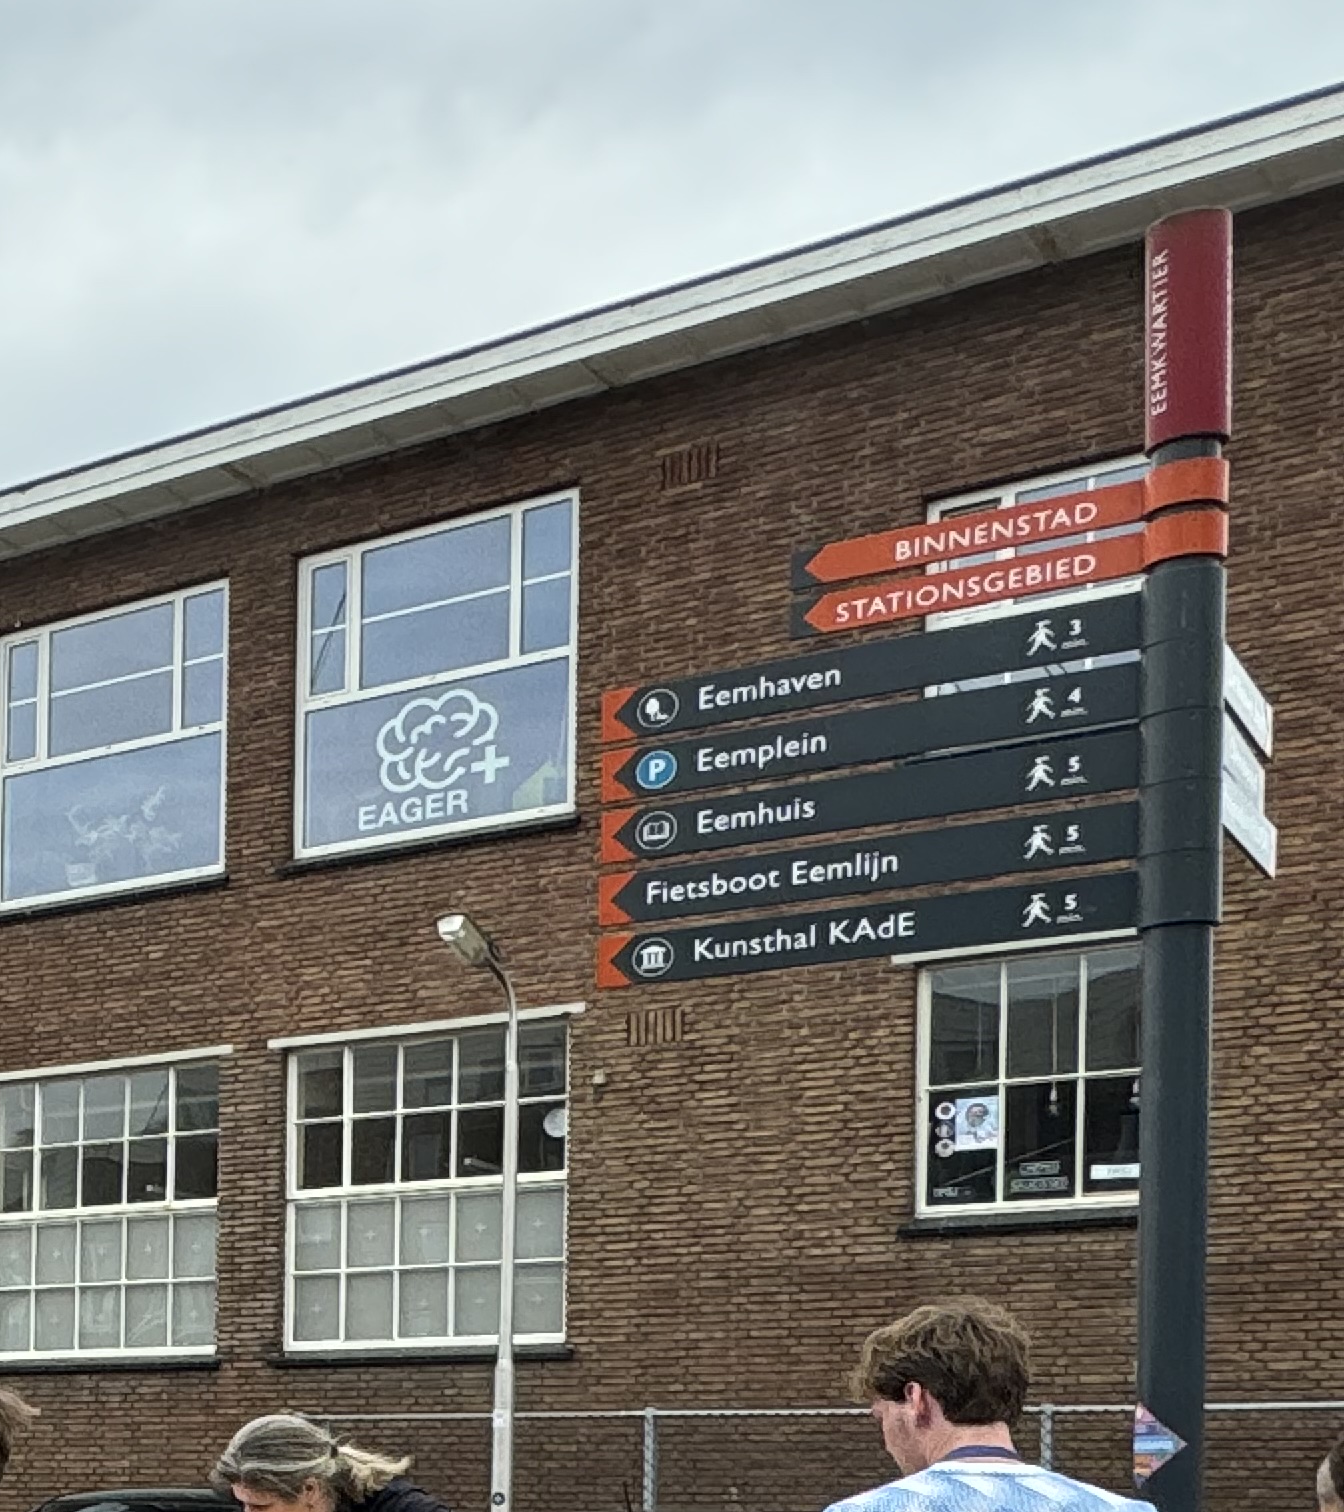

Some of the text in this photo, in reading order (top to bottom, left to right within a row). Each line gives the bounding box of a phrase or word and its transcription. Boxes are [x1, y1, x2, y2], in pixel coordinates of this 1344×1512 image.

[1150, 249, 1170, 416] EEMKWARTIER
[894, 502, 1098, 562] BINNENSTAD
[835, 554, 1096, 623] STATIONSGEBIED
[698, 618, 1082, 711] Eemhaven 3
[697, 733, 827, 773] Eemplein
[1067, 686, 1082, 704] 4
[358, 788, 468, 832] EAGER
[697, 755, 1081, 834] Eemhuis 5
[645, 824, 1080, 906] Fietsboot Eemlijn 5
[693, 893, 1078, 962] Kunsthal KAdE 5
